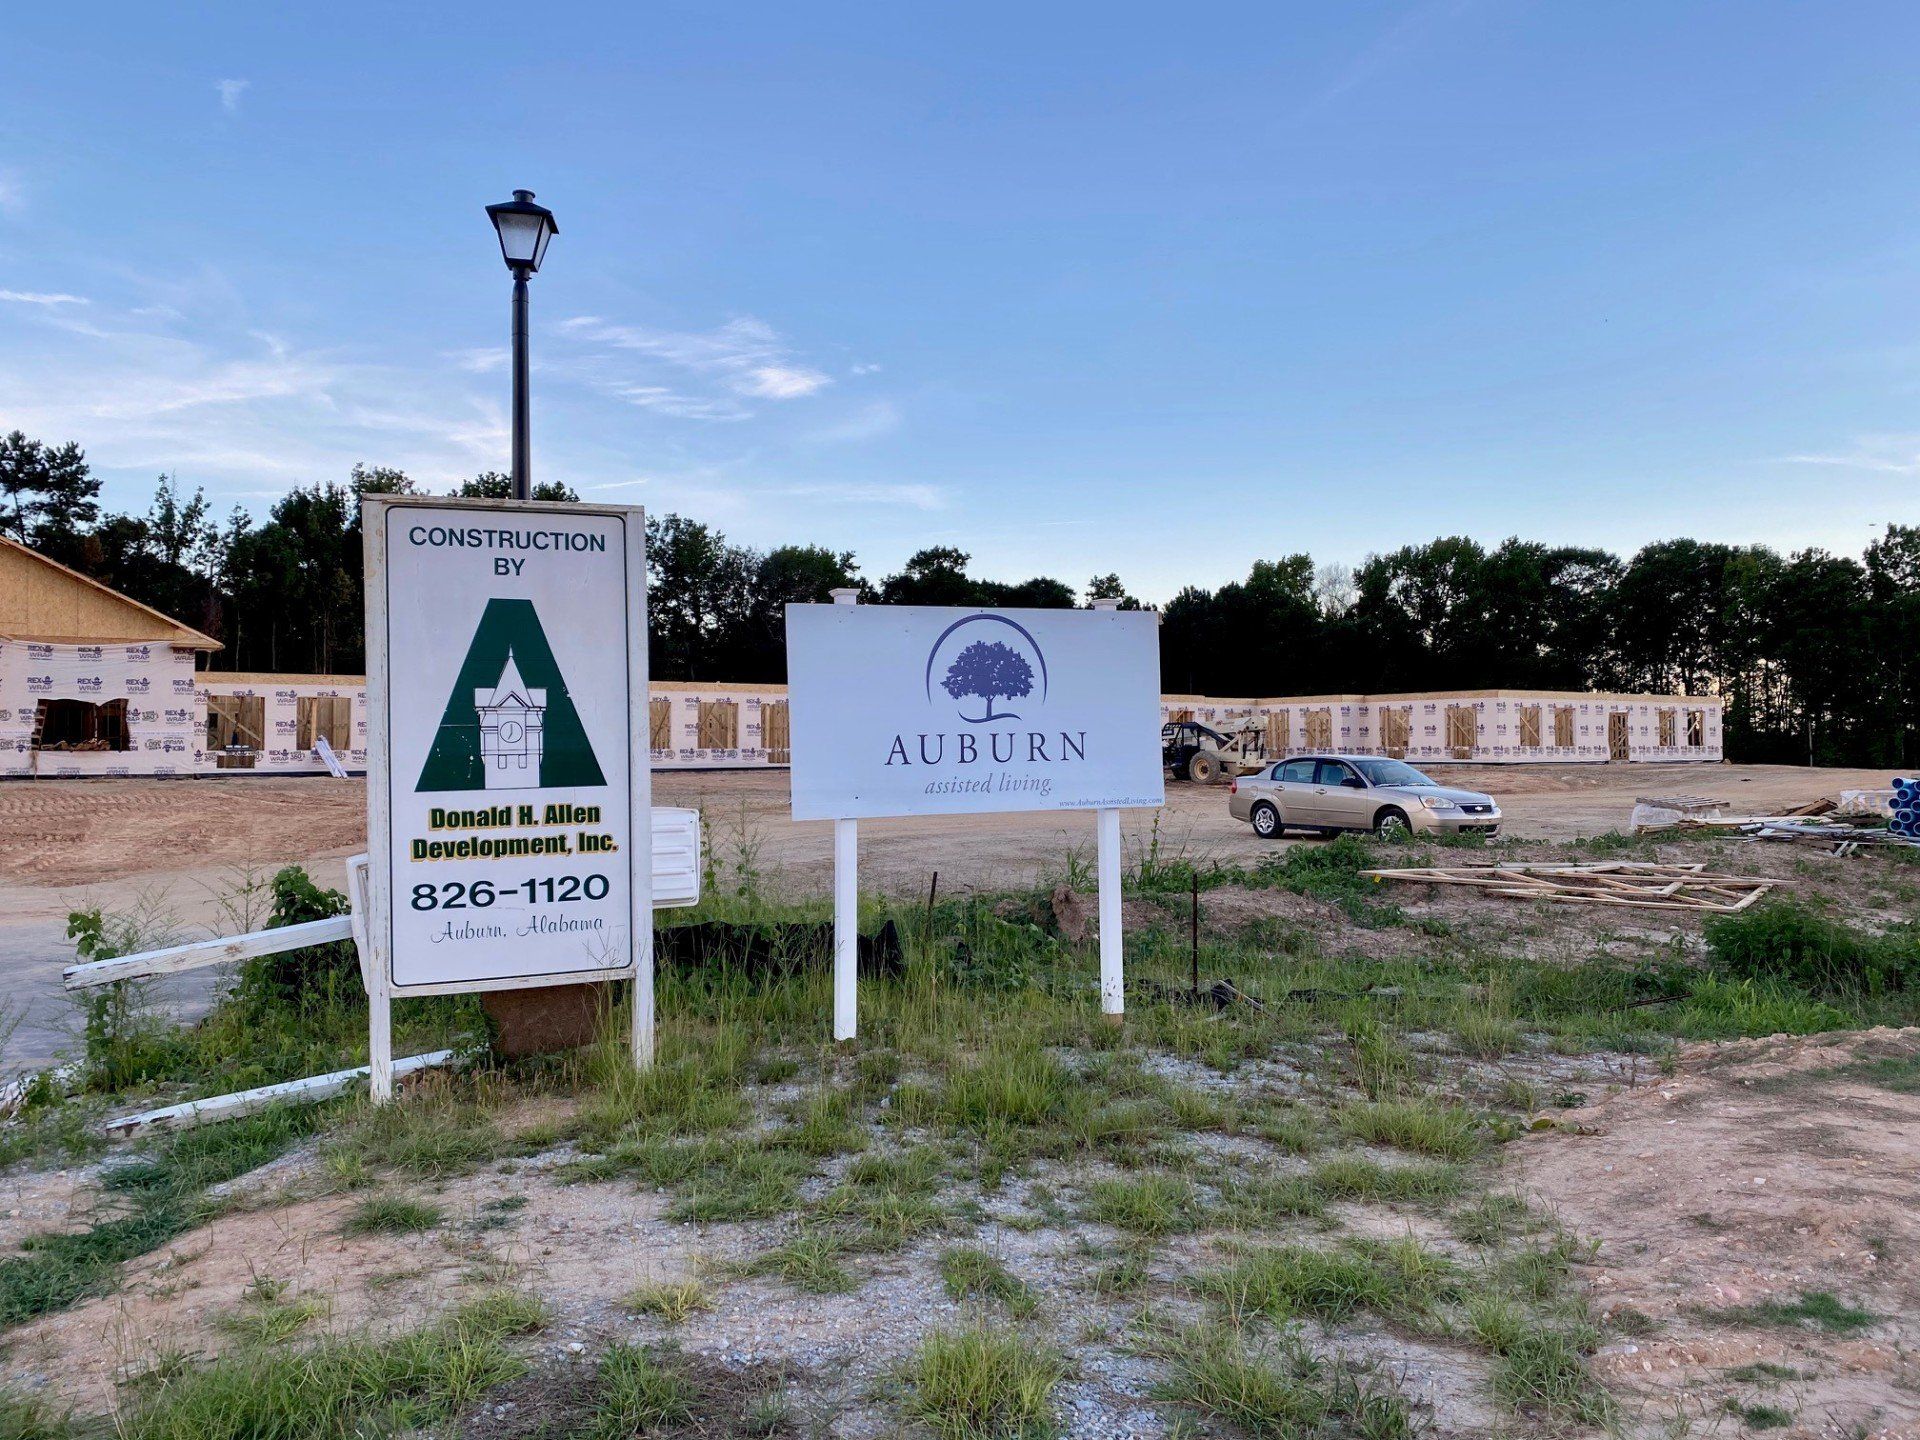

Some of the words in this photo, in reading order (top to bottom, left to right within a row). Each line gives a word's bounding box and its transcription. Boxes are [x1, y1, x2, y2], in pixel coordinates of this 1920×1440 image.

[409, 526, 605, 551] CONSTRUCTION
[494, 558, 525, 576] BY
[884, 732, 1087, 766] AUBURN
[925, 773, 994, 795] assisted
[429, 806, 512, 831] Donald
[517, 804, 540, 828] H.
[541, 803, 602, 827] Allen
[411, 833, 573, 862] Development,
[576, 831, 620, 855] Inc.
[410, 873, 611, 912] 826-1120
[516, 913, 604, 938] Alabama
